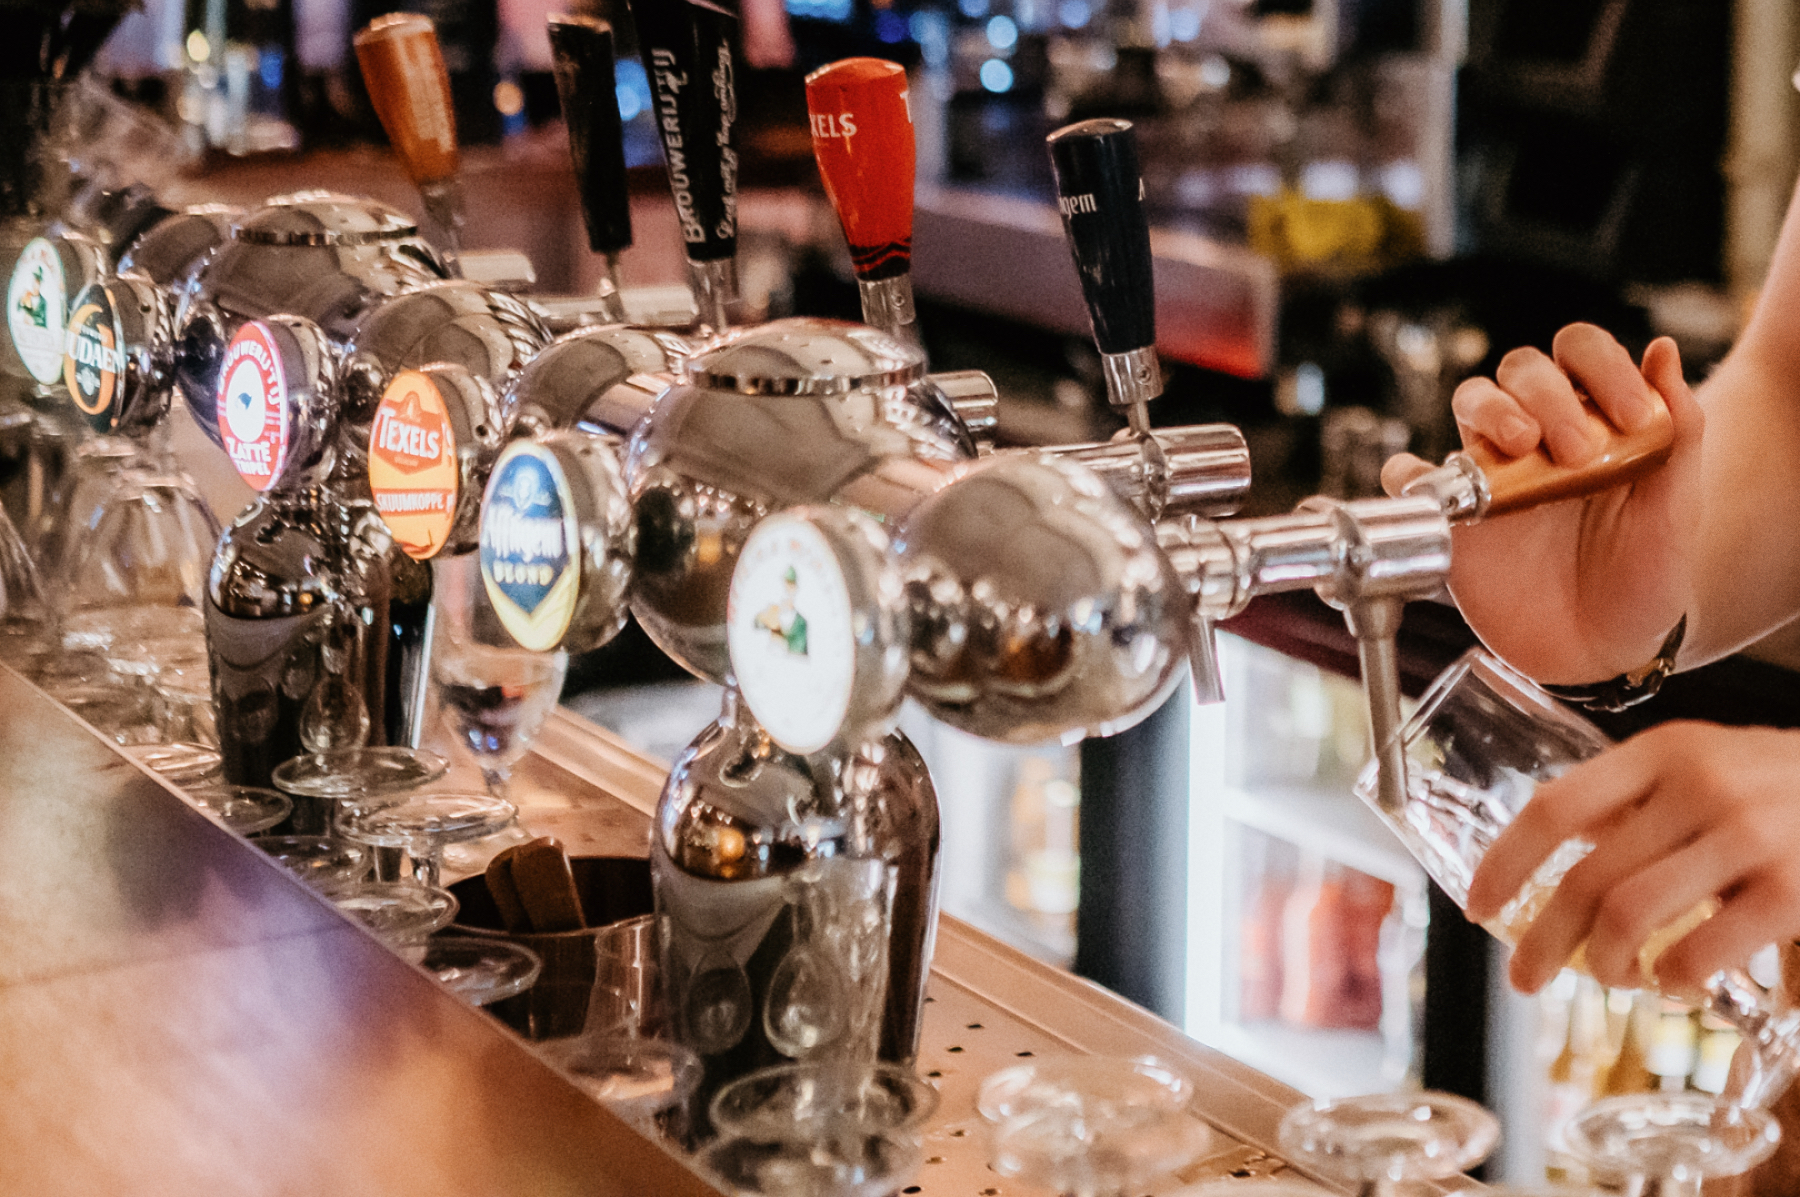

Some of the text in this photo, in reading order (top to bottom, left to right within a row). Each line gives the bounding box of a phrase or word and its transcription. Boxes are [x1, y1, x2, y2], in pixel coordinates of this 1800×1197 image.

[660, 93, 706, 243] BROUWERIJ
[68, 328, 123, 374] UDAEN
[226, 436, 271, 462] ZATTE
[379, 406, 441, 459] TEXELS
[376, 492, 444, 511] SKUUMKOPPE
[493, 560, 554, 586] BLOND
